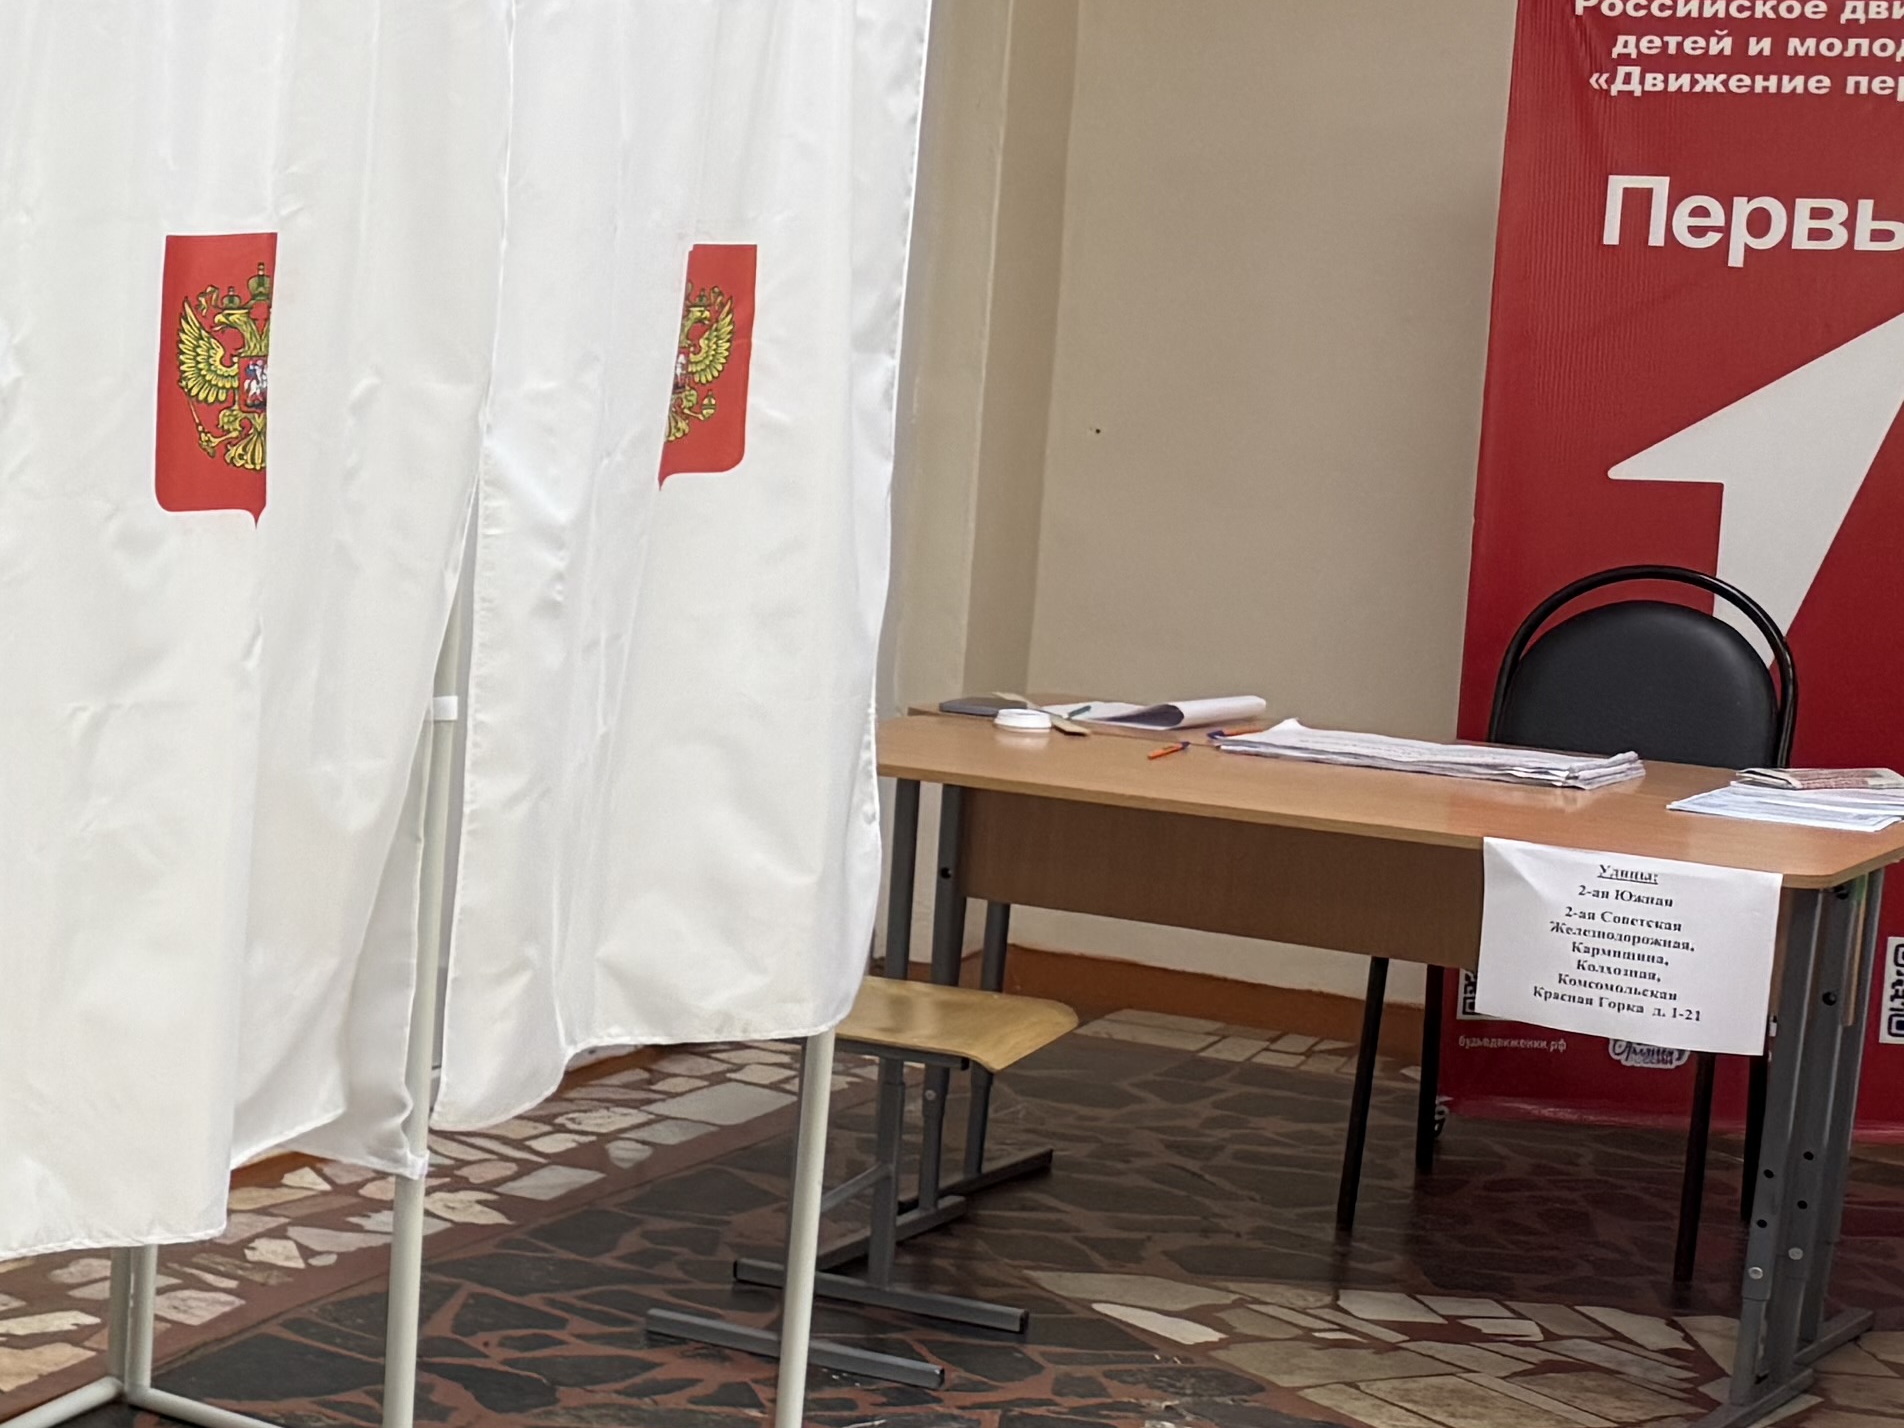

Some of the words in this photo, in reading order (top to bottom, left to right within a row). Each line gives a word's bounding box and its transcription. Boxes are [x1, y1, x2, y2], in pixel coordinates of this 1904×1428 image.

[1612, 29, 1732, 59] детей
[1748, 37, 1771, 56] и
[1589, 65, 1831, 96] «Движение
[1614, 889, 1674, 907] Южная
[1600, 911, 1682, 932] Советская
[1533, 986, 1593, 1006] Красная
[1598, 997, 1645, 1014] Горка
[1557, 973, 1677, 1001] Комсомольская
